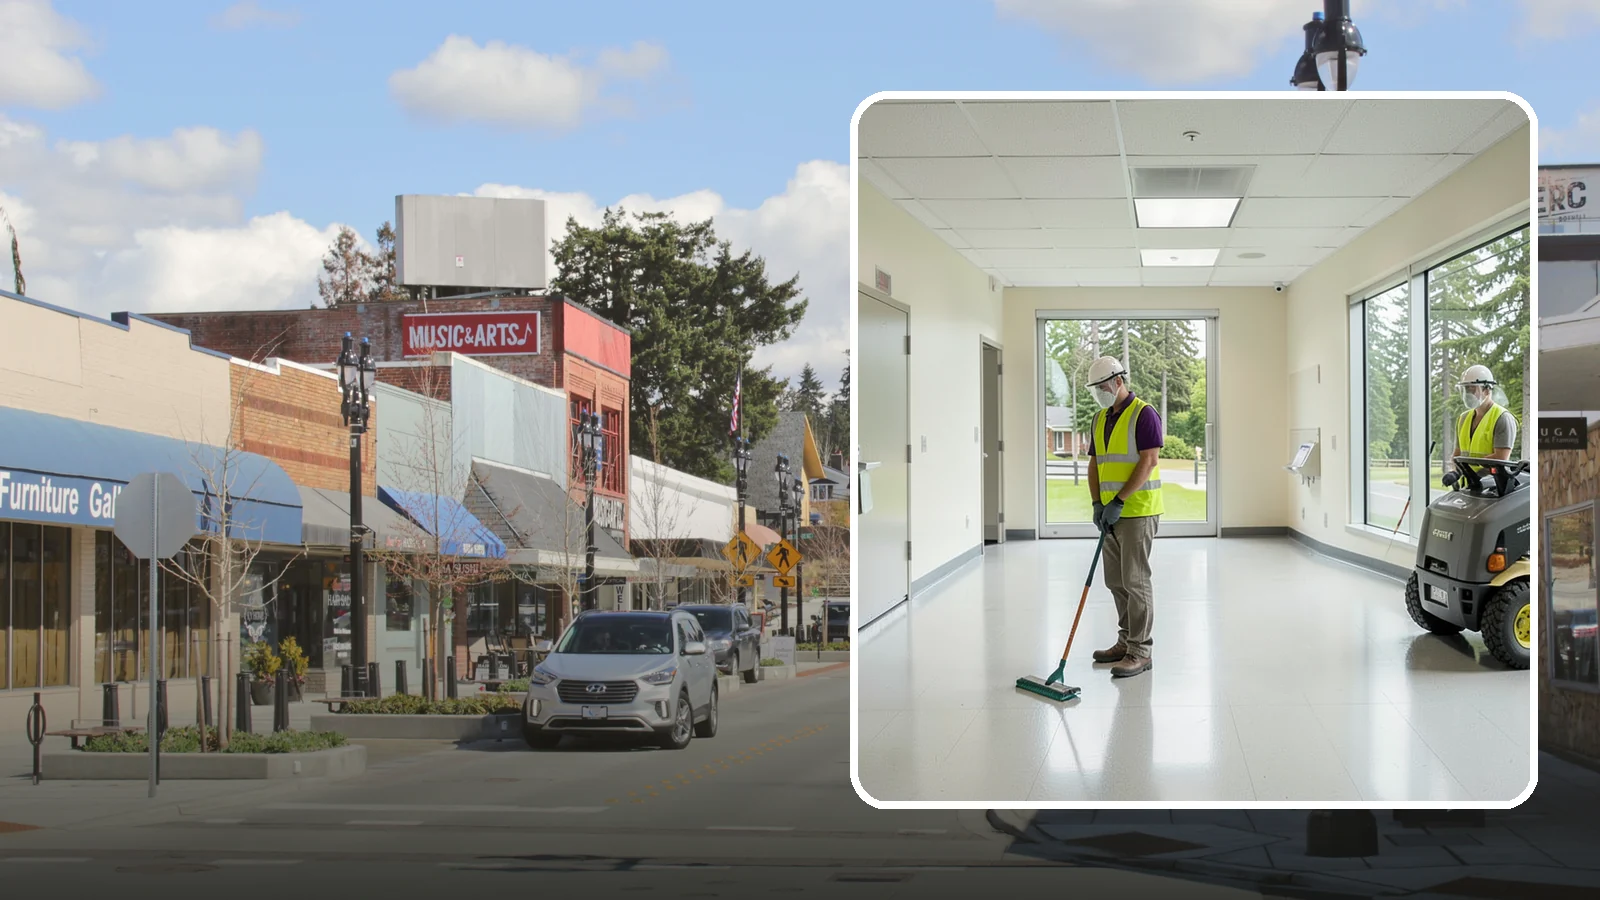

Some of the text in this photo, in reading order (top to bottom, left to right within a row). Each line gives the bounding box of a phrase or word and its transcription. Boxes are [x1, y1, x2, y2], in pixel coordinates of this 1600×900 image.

[409, 323, 520, 349] MUSIC&ARTS
[0, 471, 79, 515] Furniture
[453, 563, 480, 574] SUSHI
